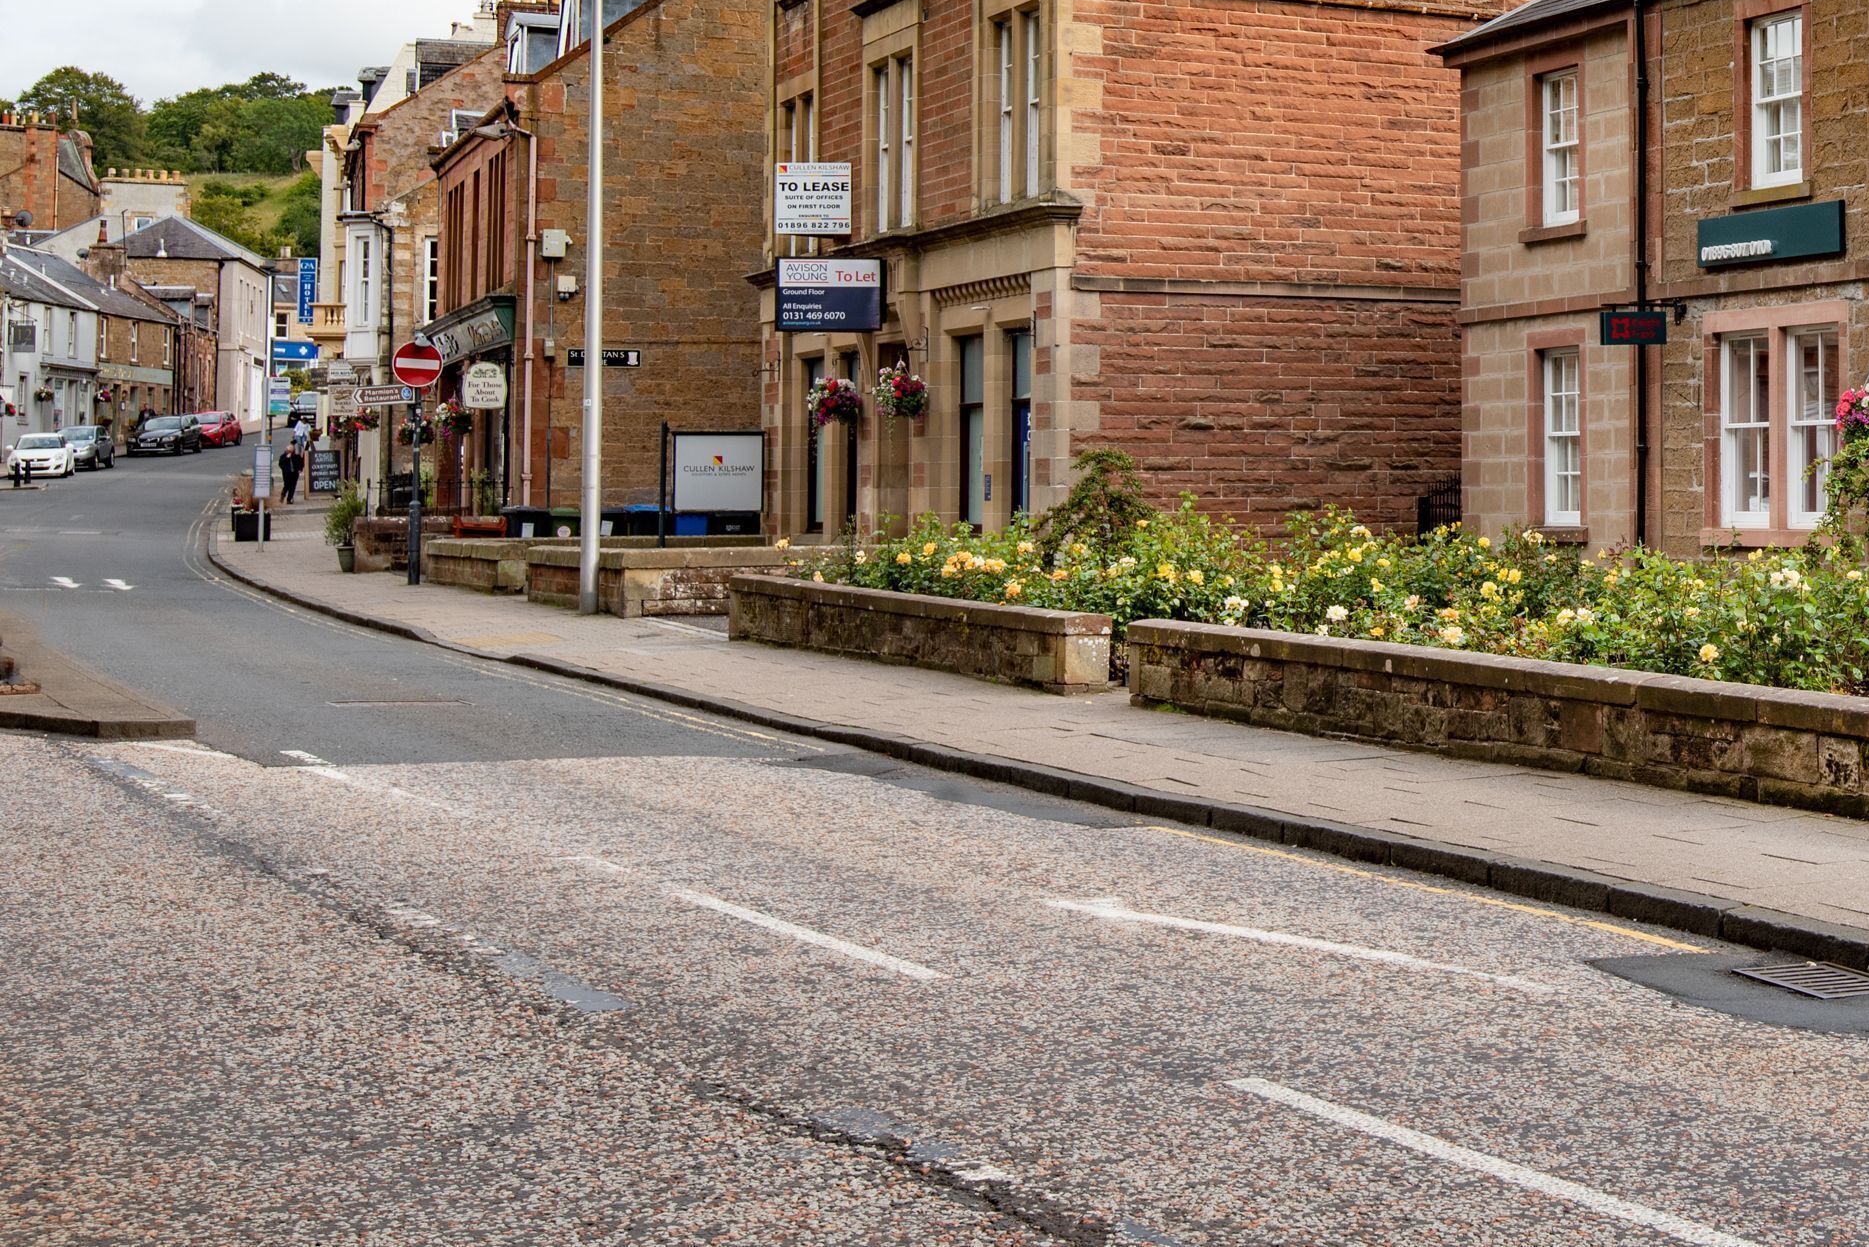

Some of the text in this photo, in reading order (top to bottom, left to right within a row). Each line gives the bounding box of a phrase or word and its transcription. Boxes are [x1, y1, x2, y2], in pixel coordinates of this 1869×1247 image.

[779, 182, 849, 192] TO LEASE
[786, 264, 828, 272] AVISON
[786, 272, 828, 281] YOUNG
[835, 271, 876, 282] To Let
[792, 303, 822, 311] Enquiries
[783, 312, 846, 320] 0131 469 6070
[313, 480, 337, 490] OPEN
